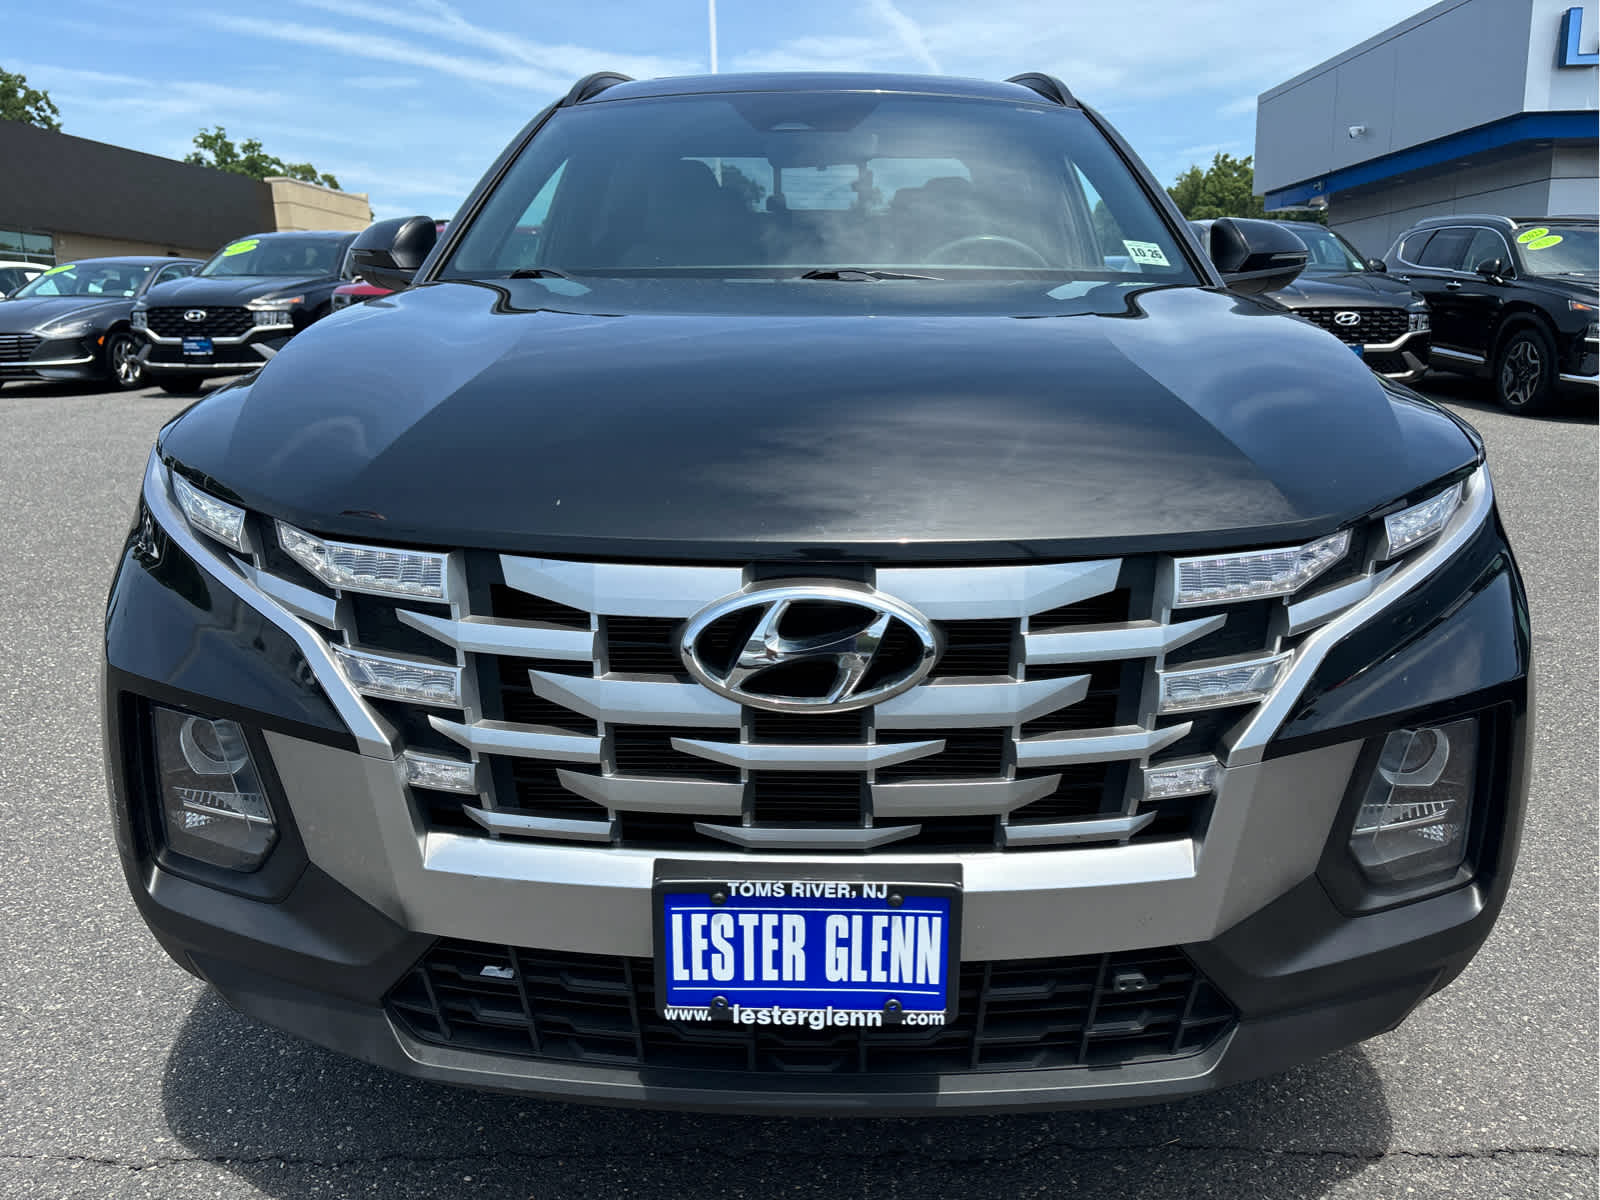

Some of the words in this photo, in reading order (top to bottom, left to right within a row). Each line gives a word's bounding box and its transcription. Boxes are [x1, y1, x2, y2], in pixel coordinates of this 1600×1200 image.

[1558, 6, 1599, 68] L
[728, 881, 785, 898] TOMS
[791, 882, 857, 899] RIVER,
[863, 883, 888, 899] NJ
[671, 913, 806, 982] LESTER
[825, 914, 942, 985] GLENN
[664, 1008, 712, 1021] www.
[733, 1004, 882, 1030] lesterglenn
[901, 1010, 945, 1026] .com
